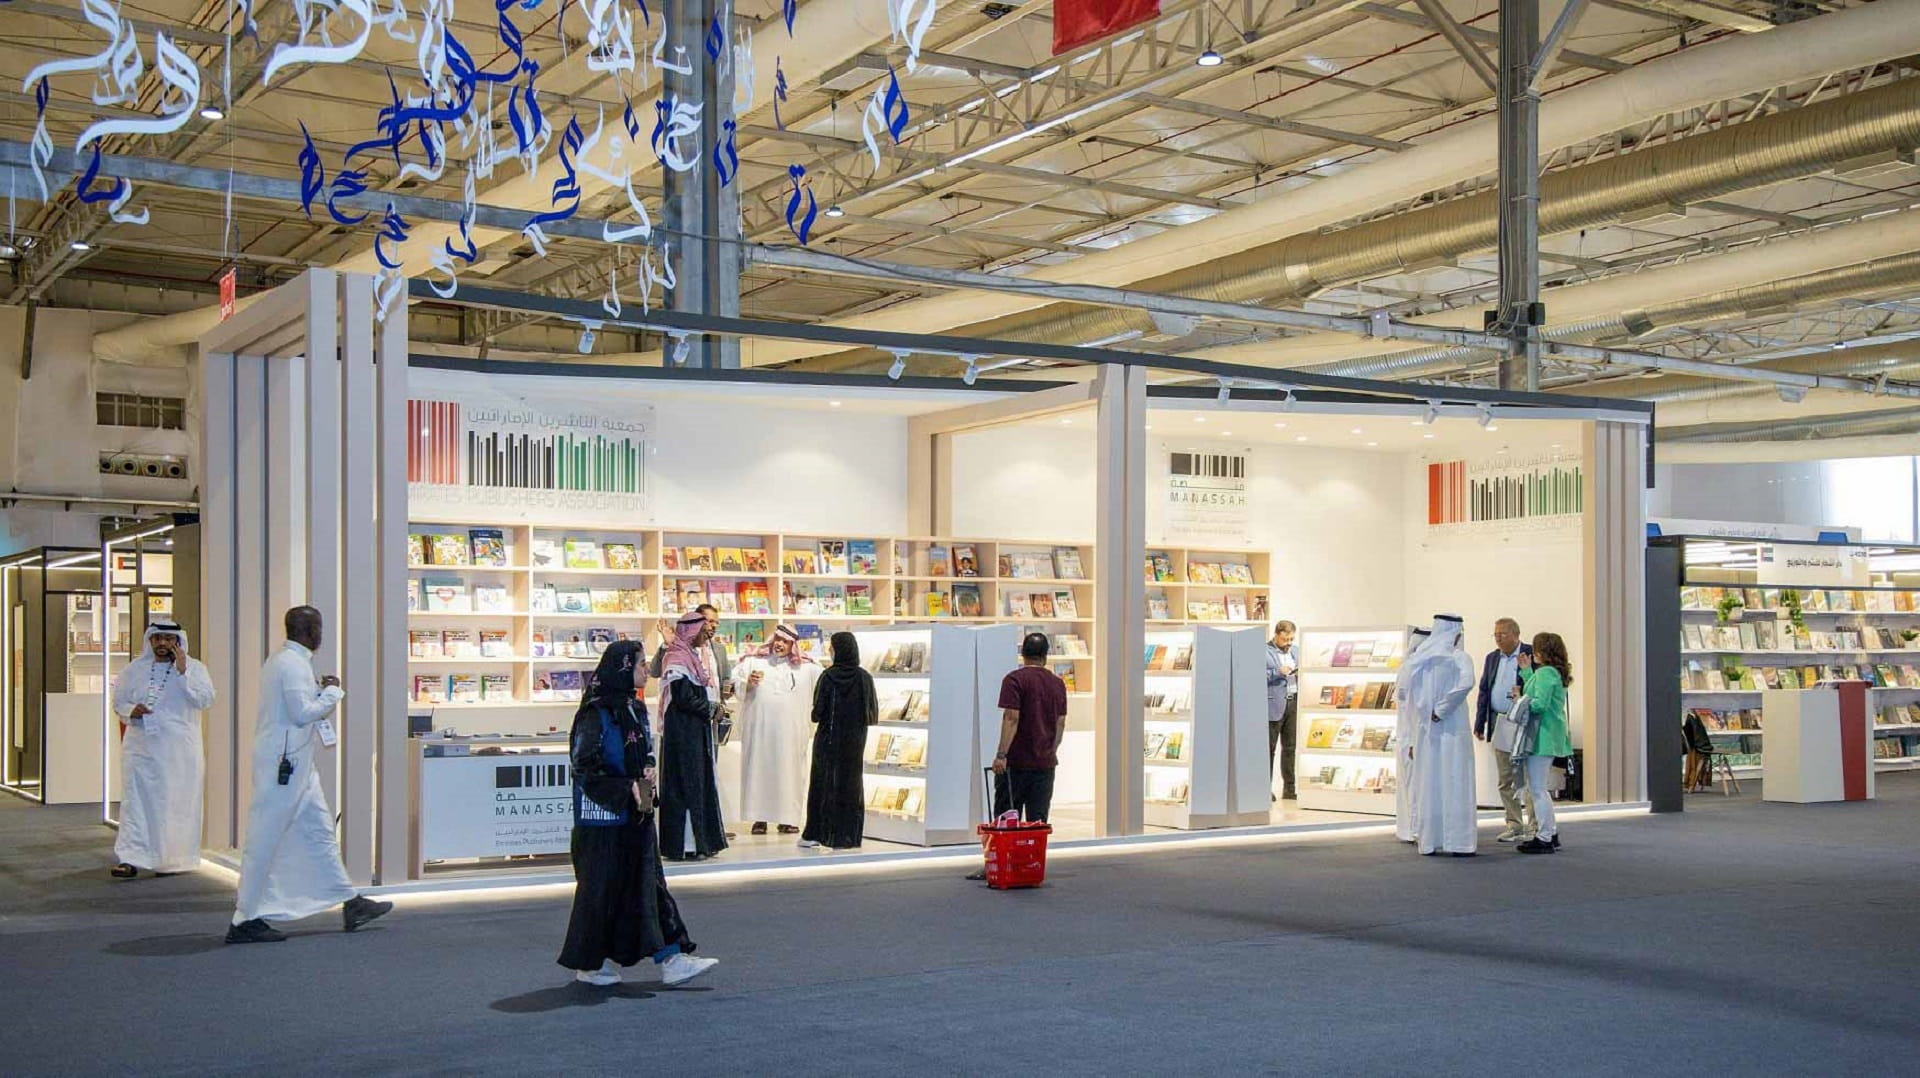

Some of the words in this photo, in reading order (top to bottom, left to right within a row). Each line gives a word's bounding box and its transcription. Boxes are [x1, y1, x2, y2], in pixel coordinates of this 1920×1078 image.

[539, 410, 597, 429] الناشرين
[558, 492, 645, 511] ASSOCIATION
[1169, 492, 1245, 506] MANASSAH
[495, 803, 574, 817] MANASSA
